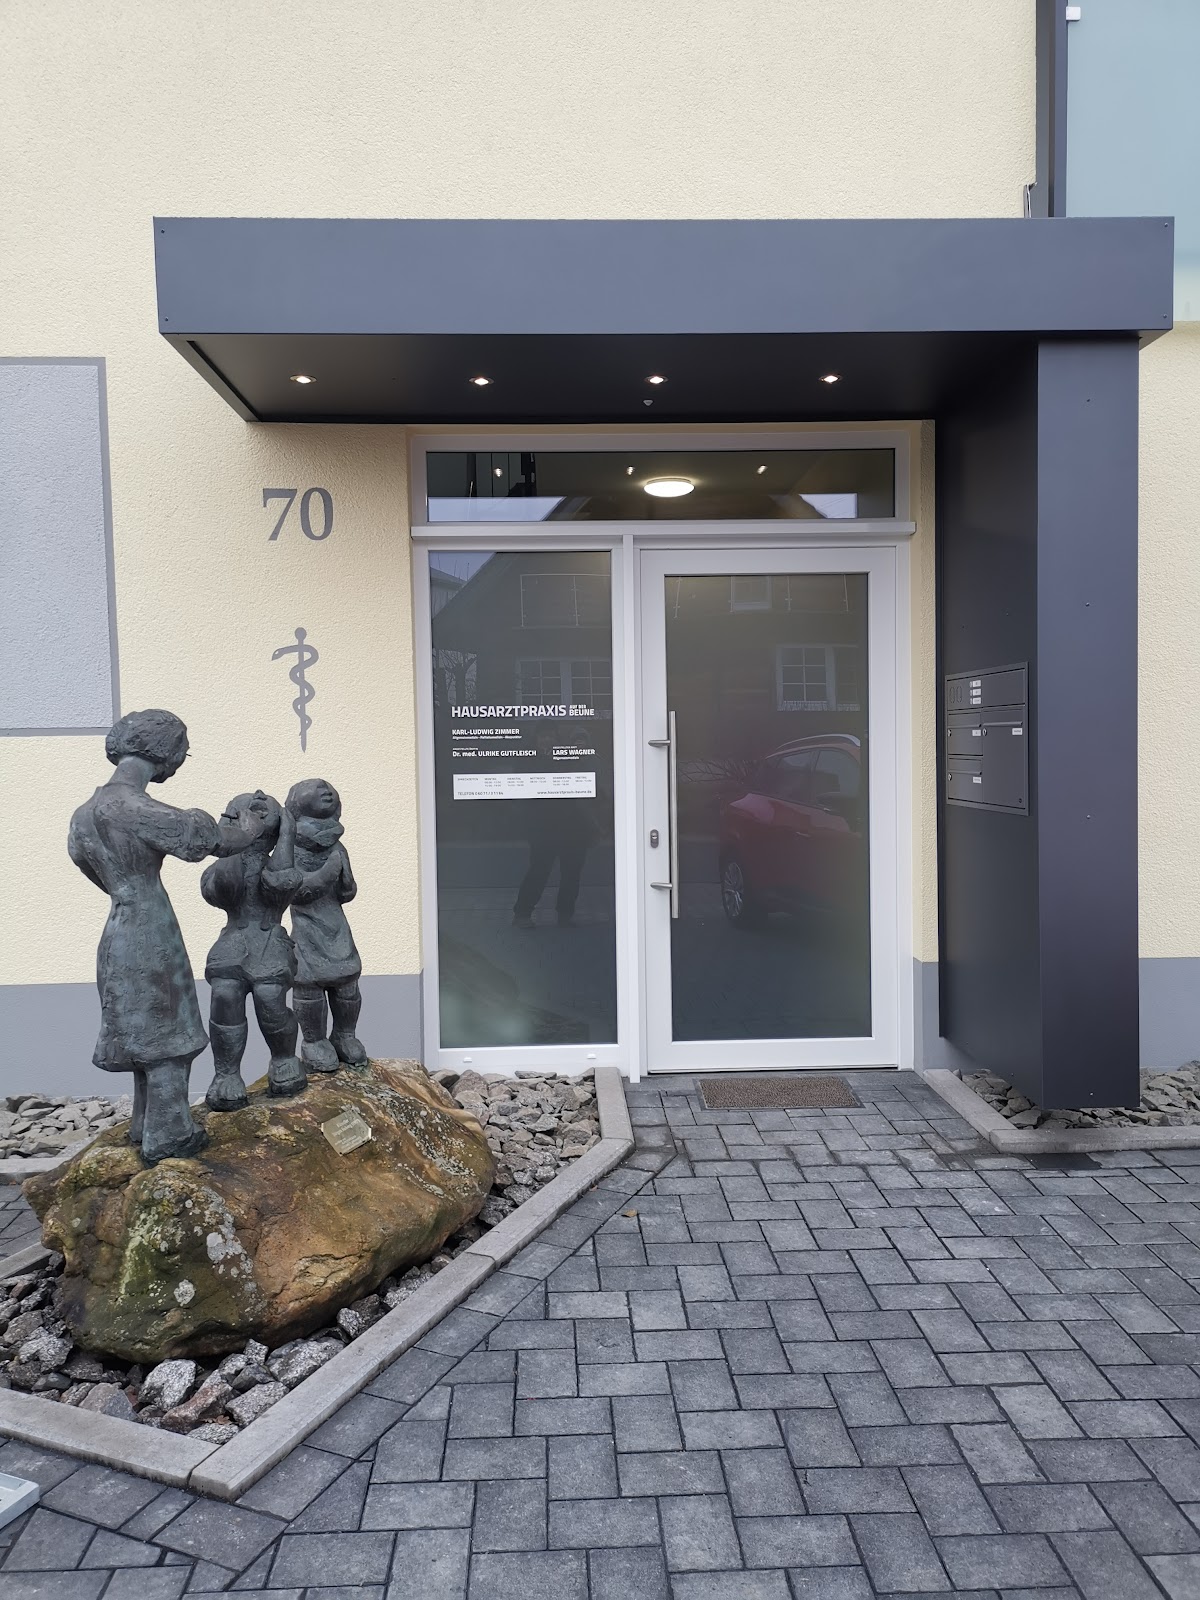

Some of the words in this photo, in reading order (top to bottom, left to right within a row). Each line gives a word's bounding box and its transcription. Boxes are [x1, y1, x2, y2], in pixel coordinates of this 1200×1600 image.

[263, 487, 334, 541] 70
[451, 705, 567, 718] HAUSARZTPRAXIS
[569, 708, 595, 716] BEUNE
[500, 749, 537, 757] GUTFLEISCH
